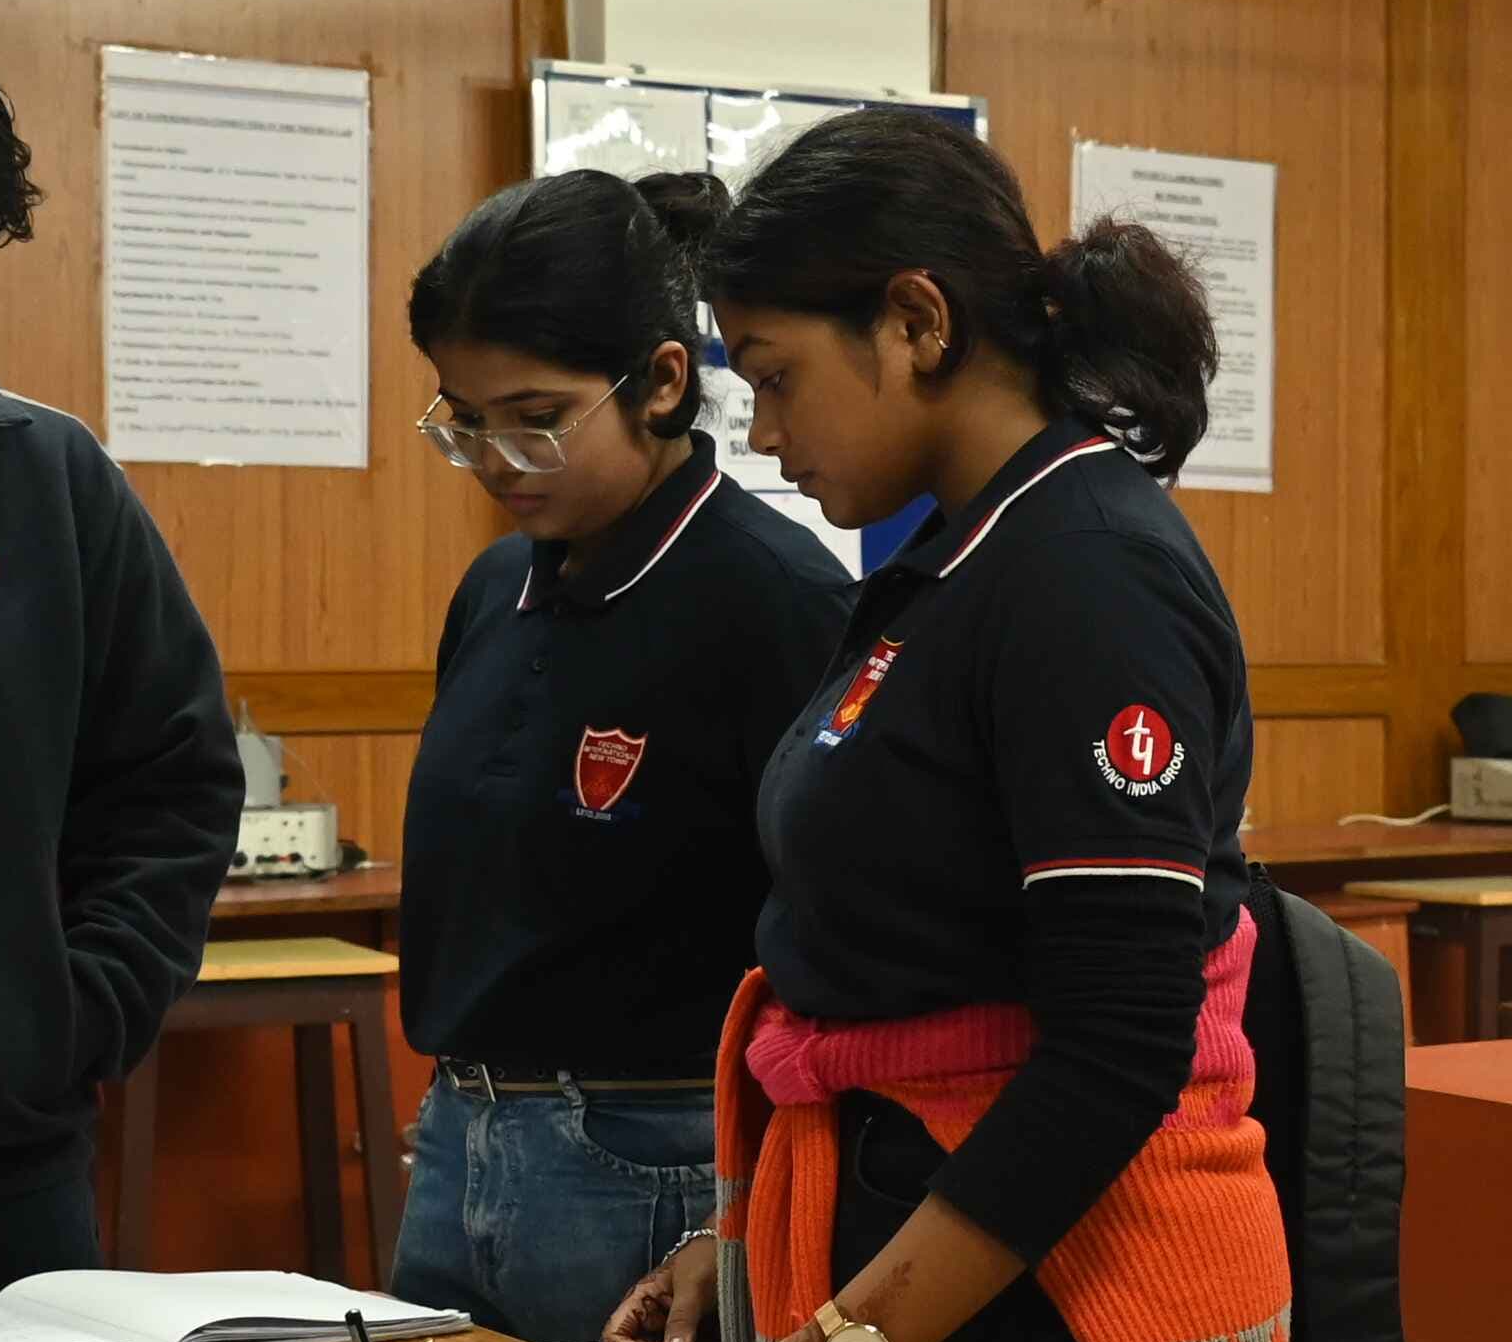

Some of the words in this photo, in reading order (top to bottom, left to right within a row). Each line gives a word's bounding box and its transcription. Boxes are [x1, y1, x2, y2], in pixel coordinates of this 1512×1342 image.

[1092, 738, 1126, 790] TECHNO
[1126, 780, 1162, 797] INDIA
[1160, 742, 1186, 786] GROUP
